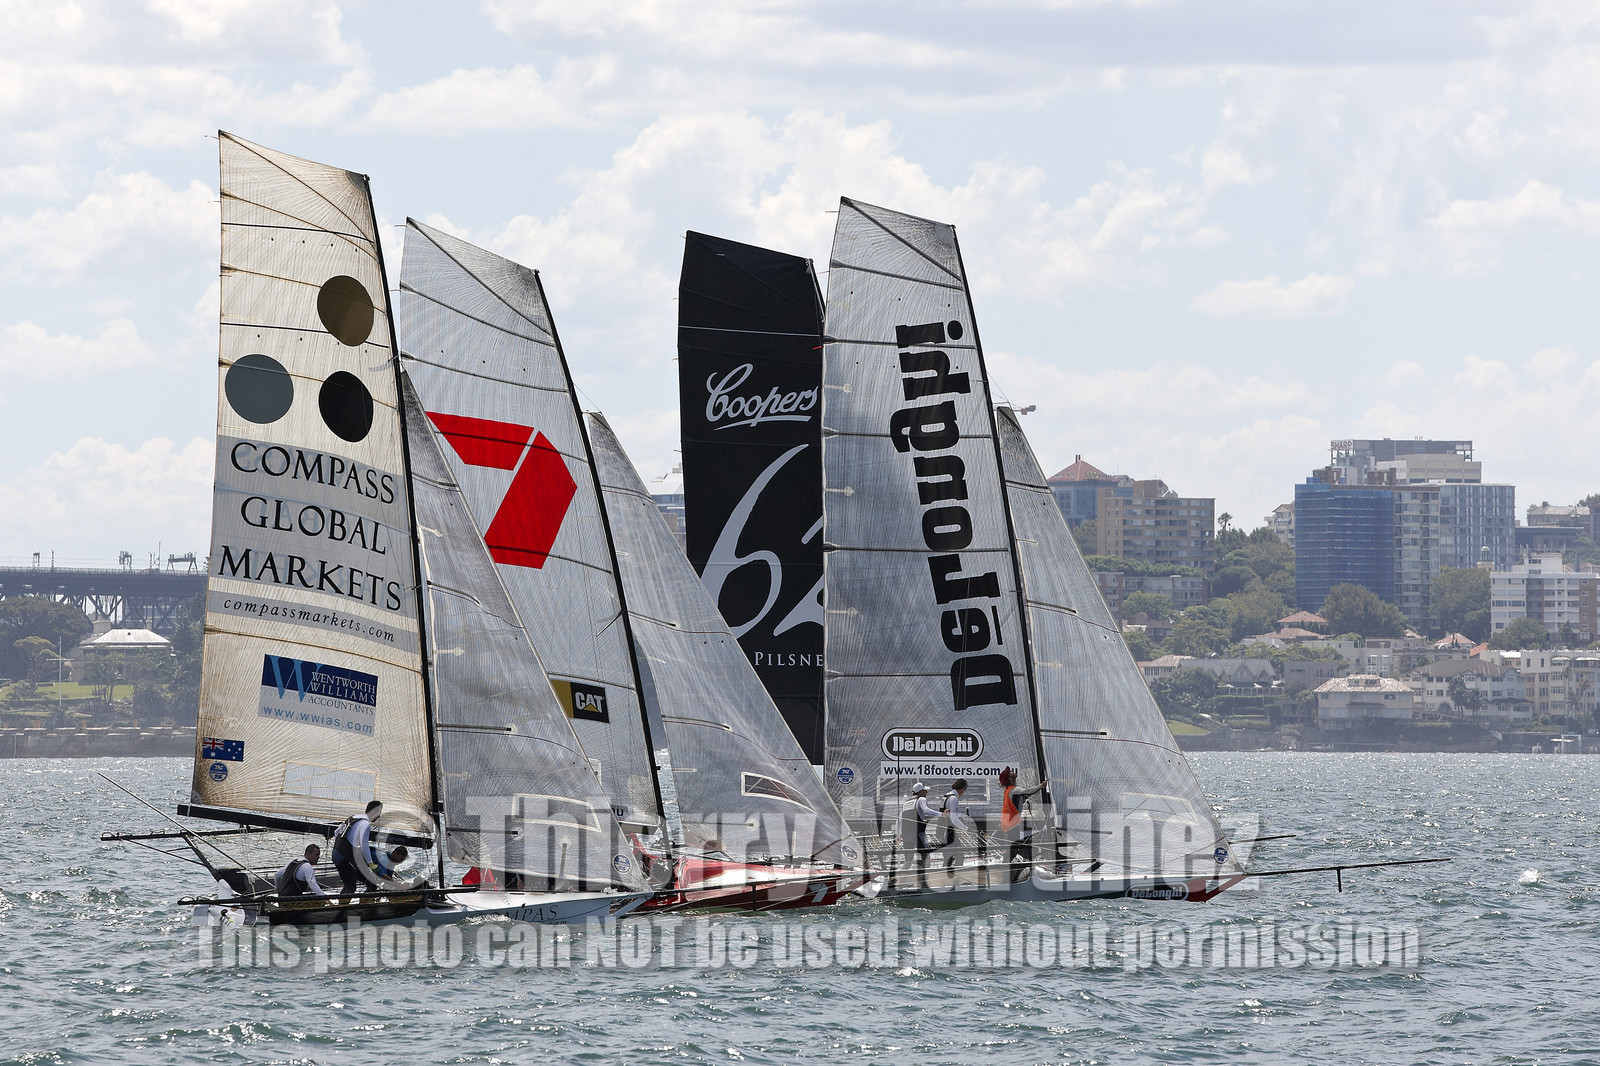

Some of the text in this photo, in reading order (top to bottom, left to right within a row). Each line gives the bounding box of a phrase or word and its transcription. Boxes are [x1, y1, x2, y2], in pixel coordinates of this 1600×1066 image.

[705, 363, 819, 428] Coopers
[230, 441, 395, 505] COMPASS
[240, 496, 387, 555] GLOBAL
[217, 545, 402, 612] MARKETS
[223, 599, 395, 642] compassmarkets.com
[310, 681, 376, 704] WILLIAMS
[311, 671, 376, 694] WENTWORTH
[308, 696, 375, 716] ACCOUNTANTS
[574, 691, 604, 713] CAT
[263, 706, 372, 734] www.wwias.com
